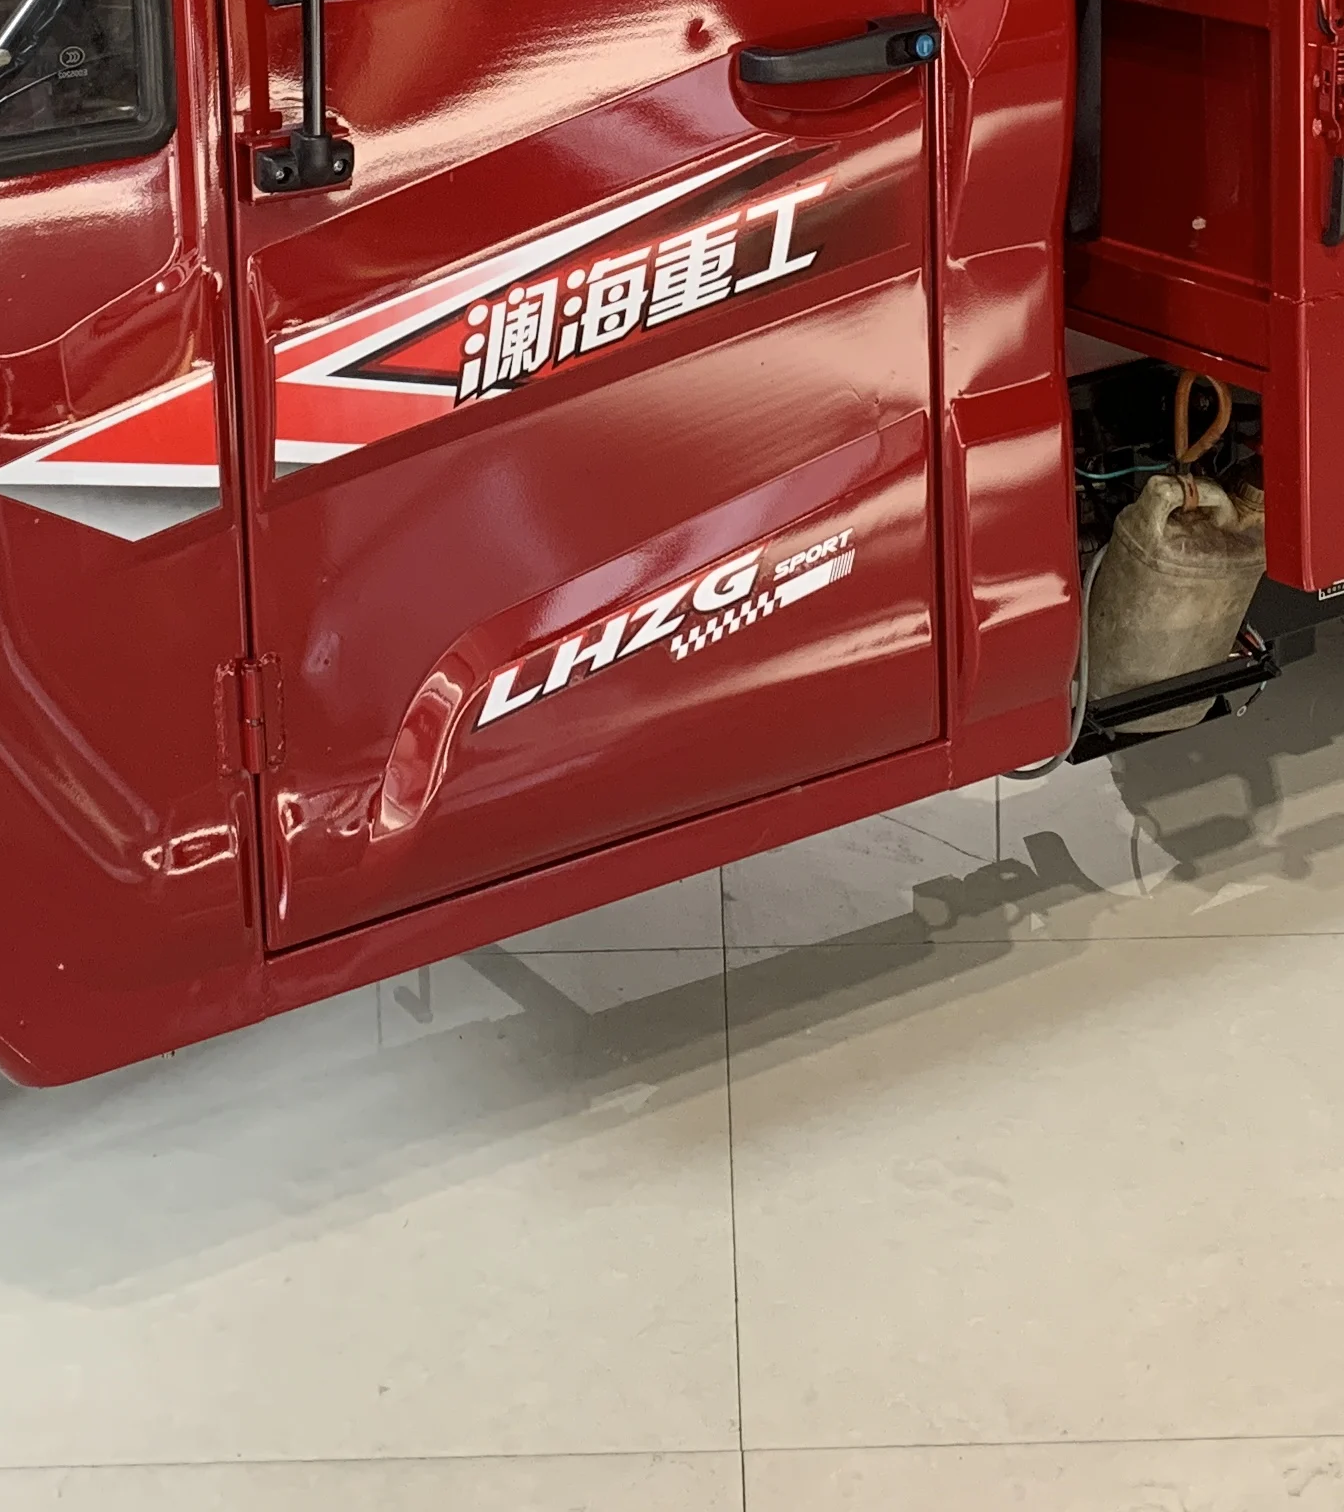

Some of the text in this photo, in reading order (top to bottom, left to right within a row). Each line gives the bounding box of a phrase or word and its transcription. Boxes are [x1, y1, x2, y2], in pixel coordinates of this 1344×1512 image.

[458, 183, 829, 400] 澜海重工
[477, 527, 854, 729] LHZG SPORT
